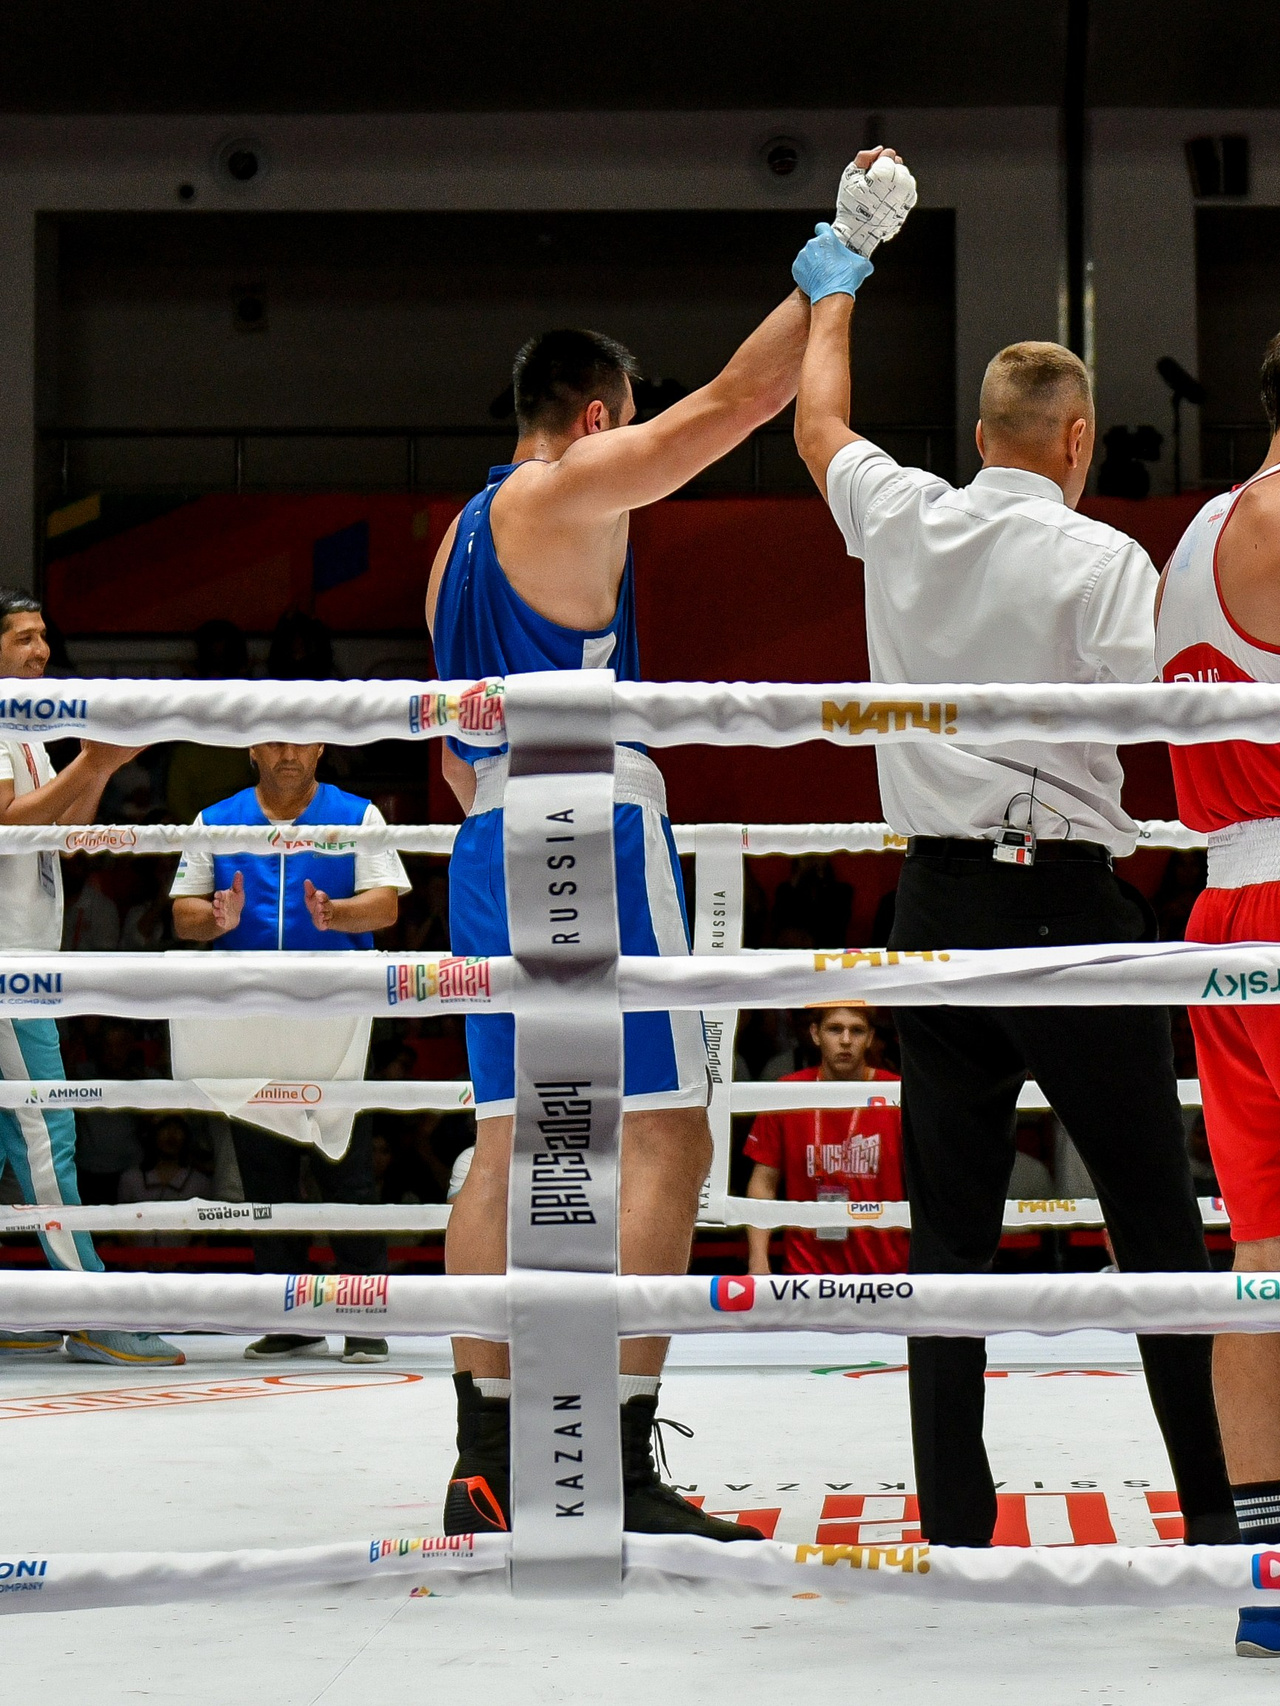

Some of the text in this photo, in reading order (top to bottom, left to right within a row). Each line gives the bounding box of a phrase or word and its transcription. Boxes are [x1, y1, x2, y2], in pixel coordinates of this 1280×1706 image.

[283, 840, 357, 850] TATNEFT
[548, 809, 580, 944] RUSSIA
[711, 890, 726, 948] RUSSIA
[49, 1088, 102, 1098] AMMONI
[198, 1208, 249, 1221] первое
[851, 1204, 880, 1212] РИМ
[770, 1278, 914, 1303] VK Видео
[555, 1394, 585, 1517] KAZAN
